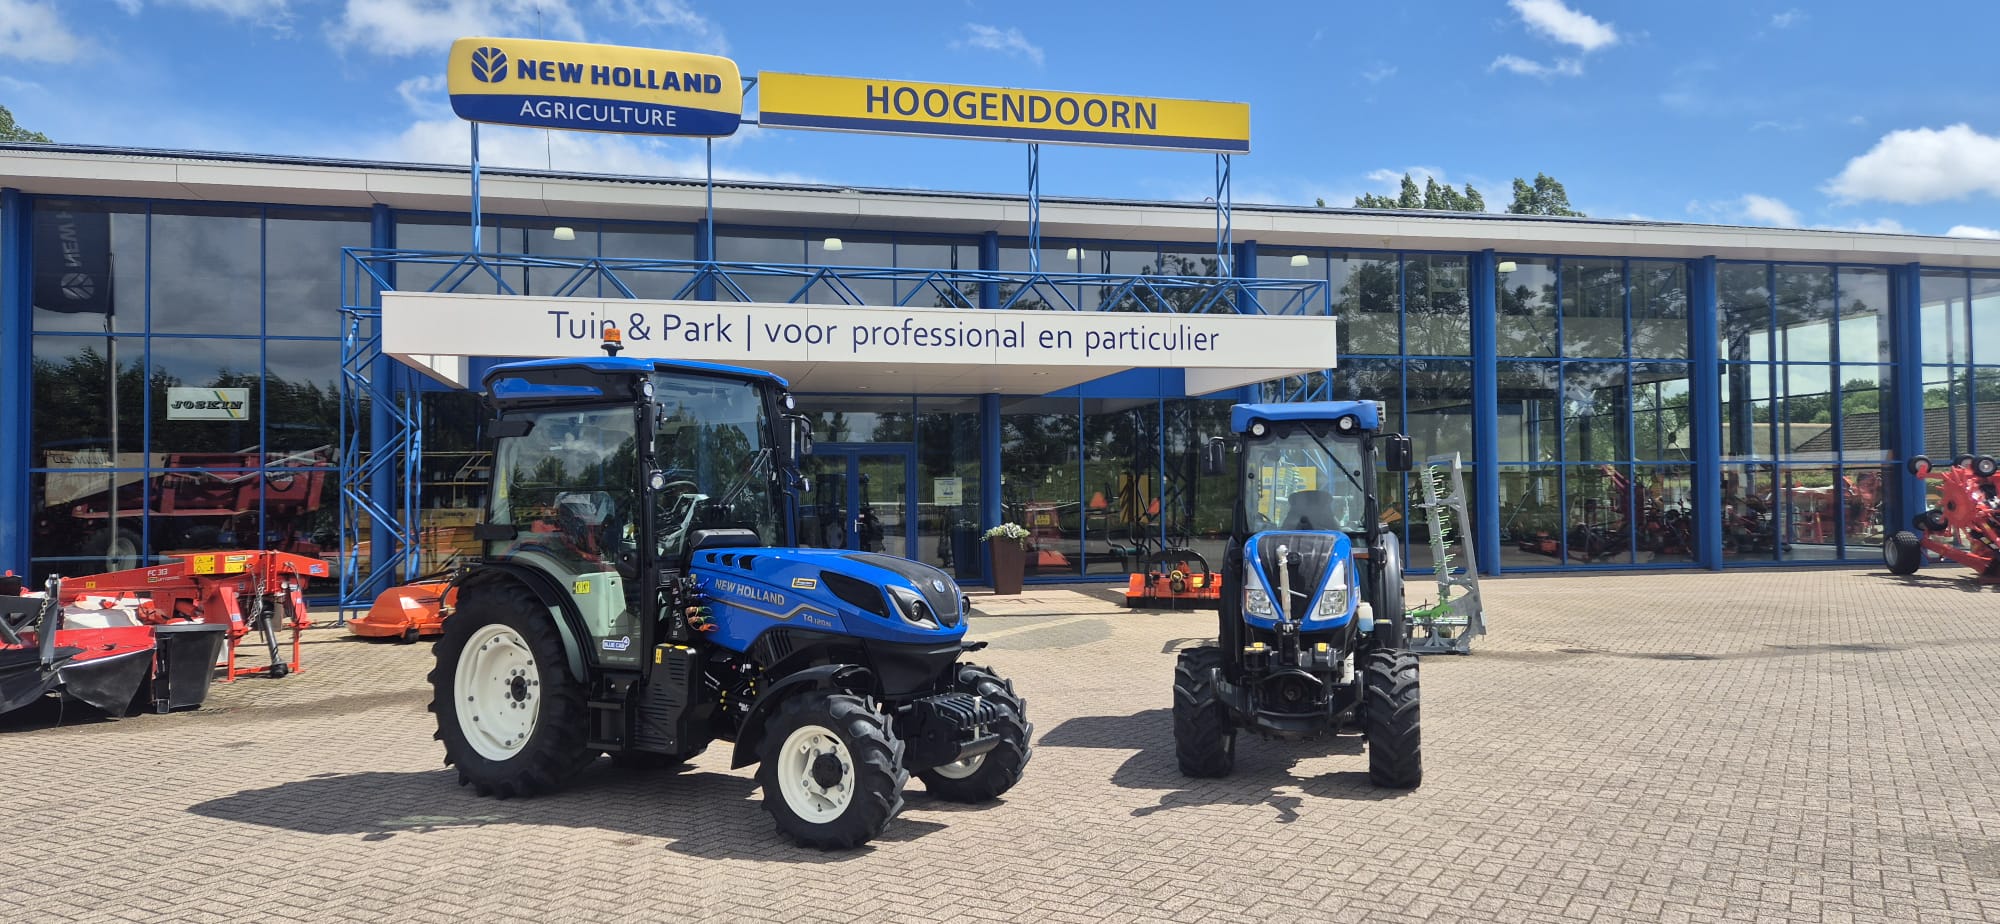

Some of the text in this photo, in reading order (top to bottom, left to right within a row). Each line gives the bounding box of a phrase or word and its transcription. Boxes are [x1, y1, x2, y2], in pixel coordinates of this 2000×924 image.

[517, 58, 722, 94] NEW HOLLAND
[519, 99, 677, 128] AGRICULTURE
[866, 84, 1157, 130] HOOGENDOORN
[547, 310, 617, 340] Tuin
[627, 312, 651, 341] &
[662, 313, 733, 342] Park
[765, 322, 838, 345] voor
[852, 317, 1025, 353] professional
[1038, 328, 1073, 349] en
[1085, 323, 1220, 357] particulier
[171, 400, 243, 410] JOSKIN
[147, 569, 157, 577] FC
[714, 578, 737, 593] NEW
[736, 583, 785, 606] HOLLAND
